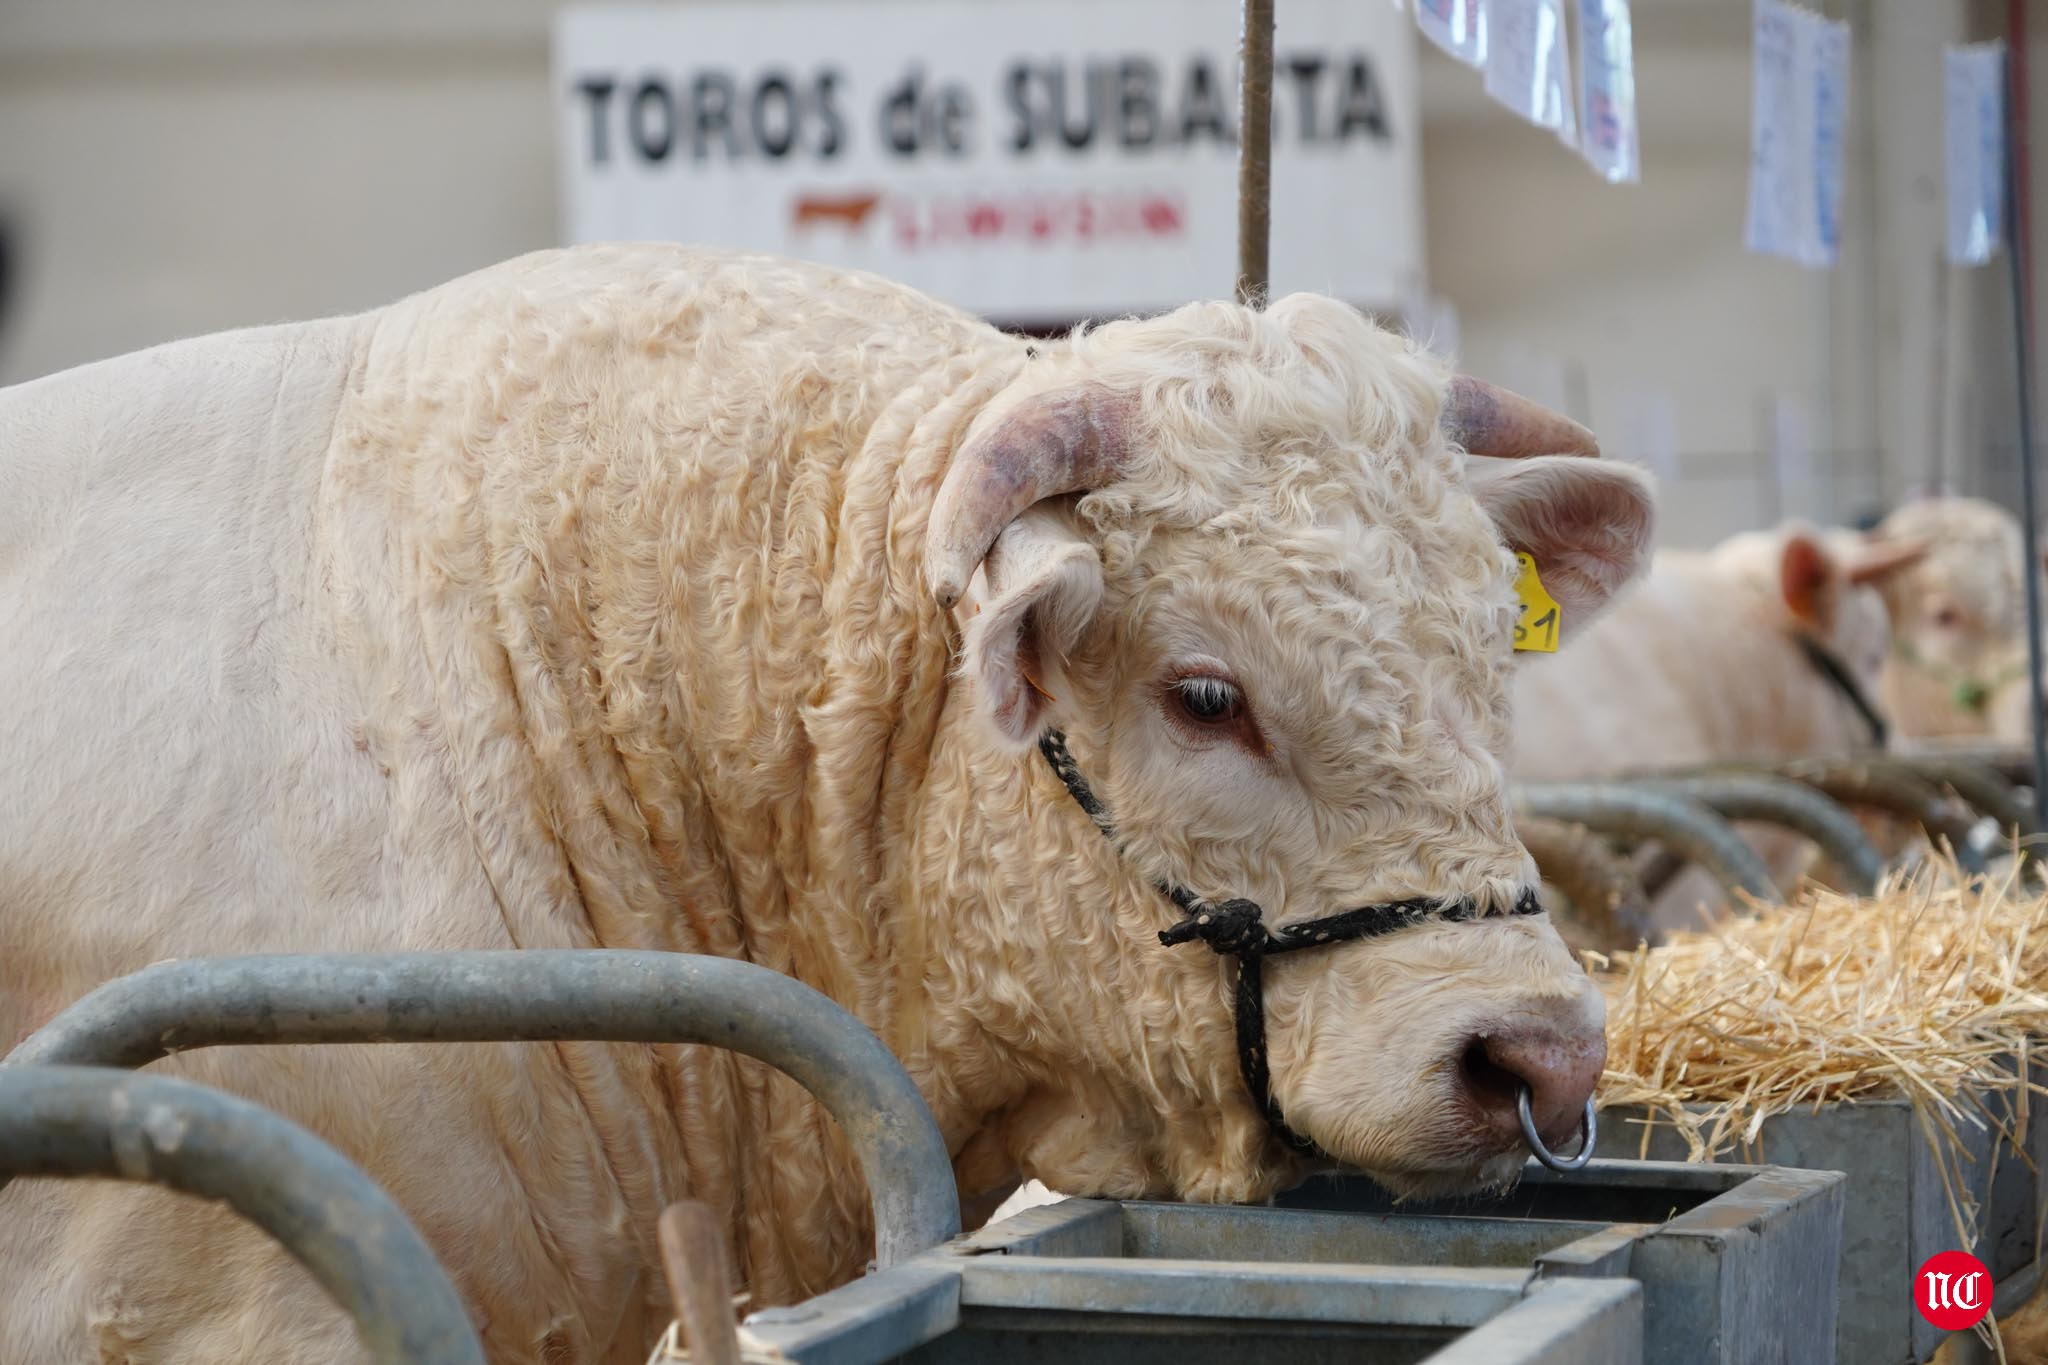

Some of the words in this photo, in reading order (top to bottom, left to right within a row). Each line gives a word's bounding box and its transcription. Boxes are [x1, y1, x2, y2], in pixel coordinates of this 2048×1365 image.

[574, 68, 850, 164] TOROS
[877, 64, 976, 158] de
[1004, 53, 1393, 152] SUBATA
